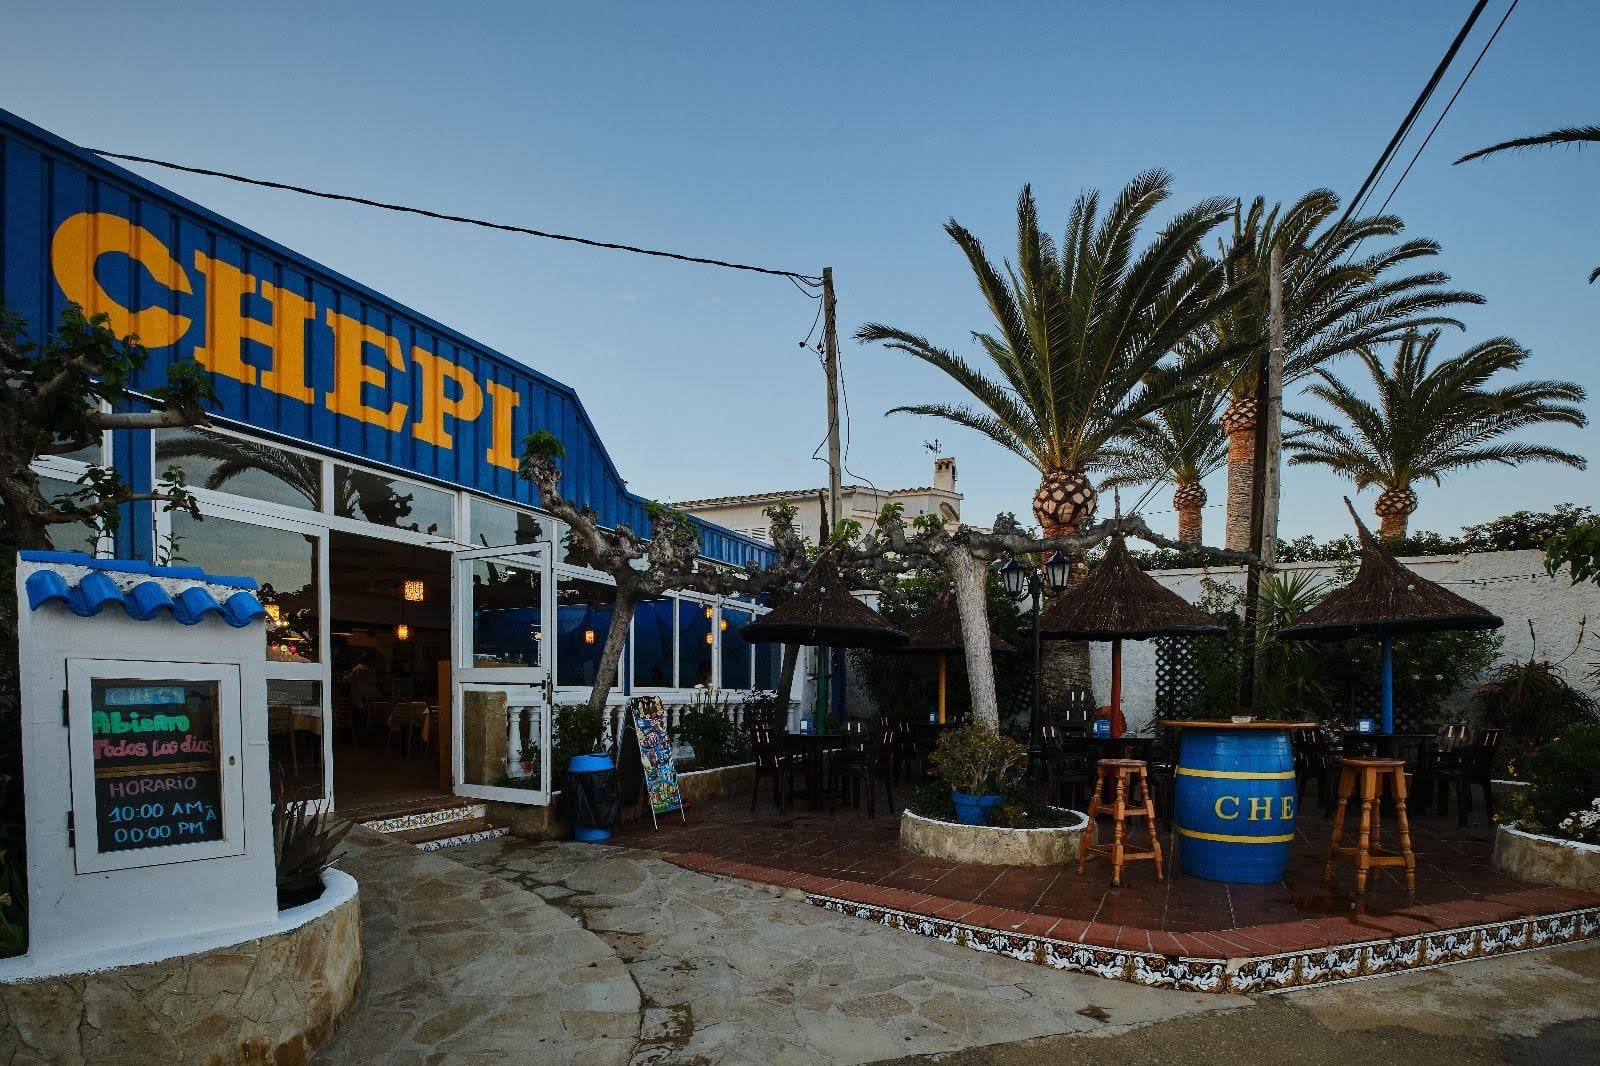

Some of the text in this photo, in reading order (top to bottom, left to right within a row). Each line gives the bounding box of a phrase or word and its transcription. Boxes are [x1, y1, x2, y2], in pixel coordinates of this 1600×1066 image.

[51, 212, 520, 472] CHEPI
[108, 803, 164, 823] 10:00
[114, 822, 205, 843] 00:00 PM
